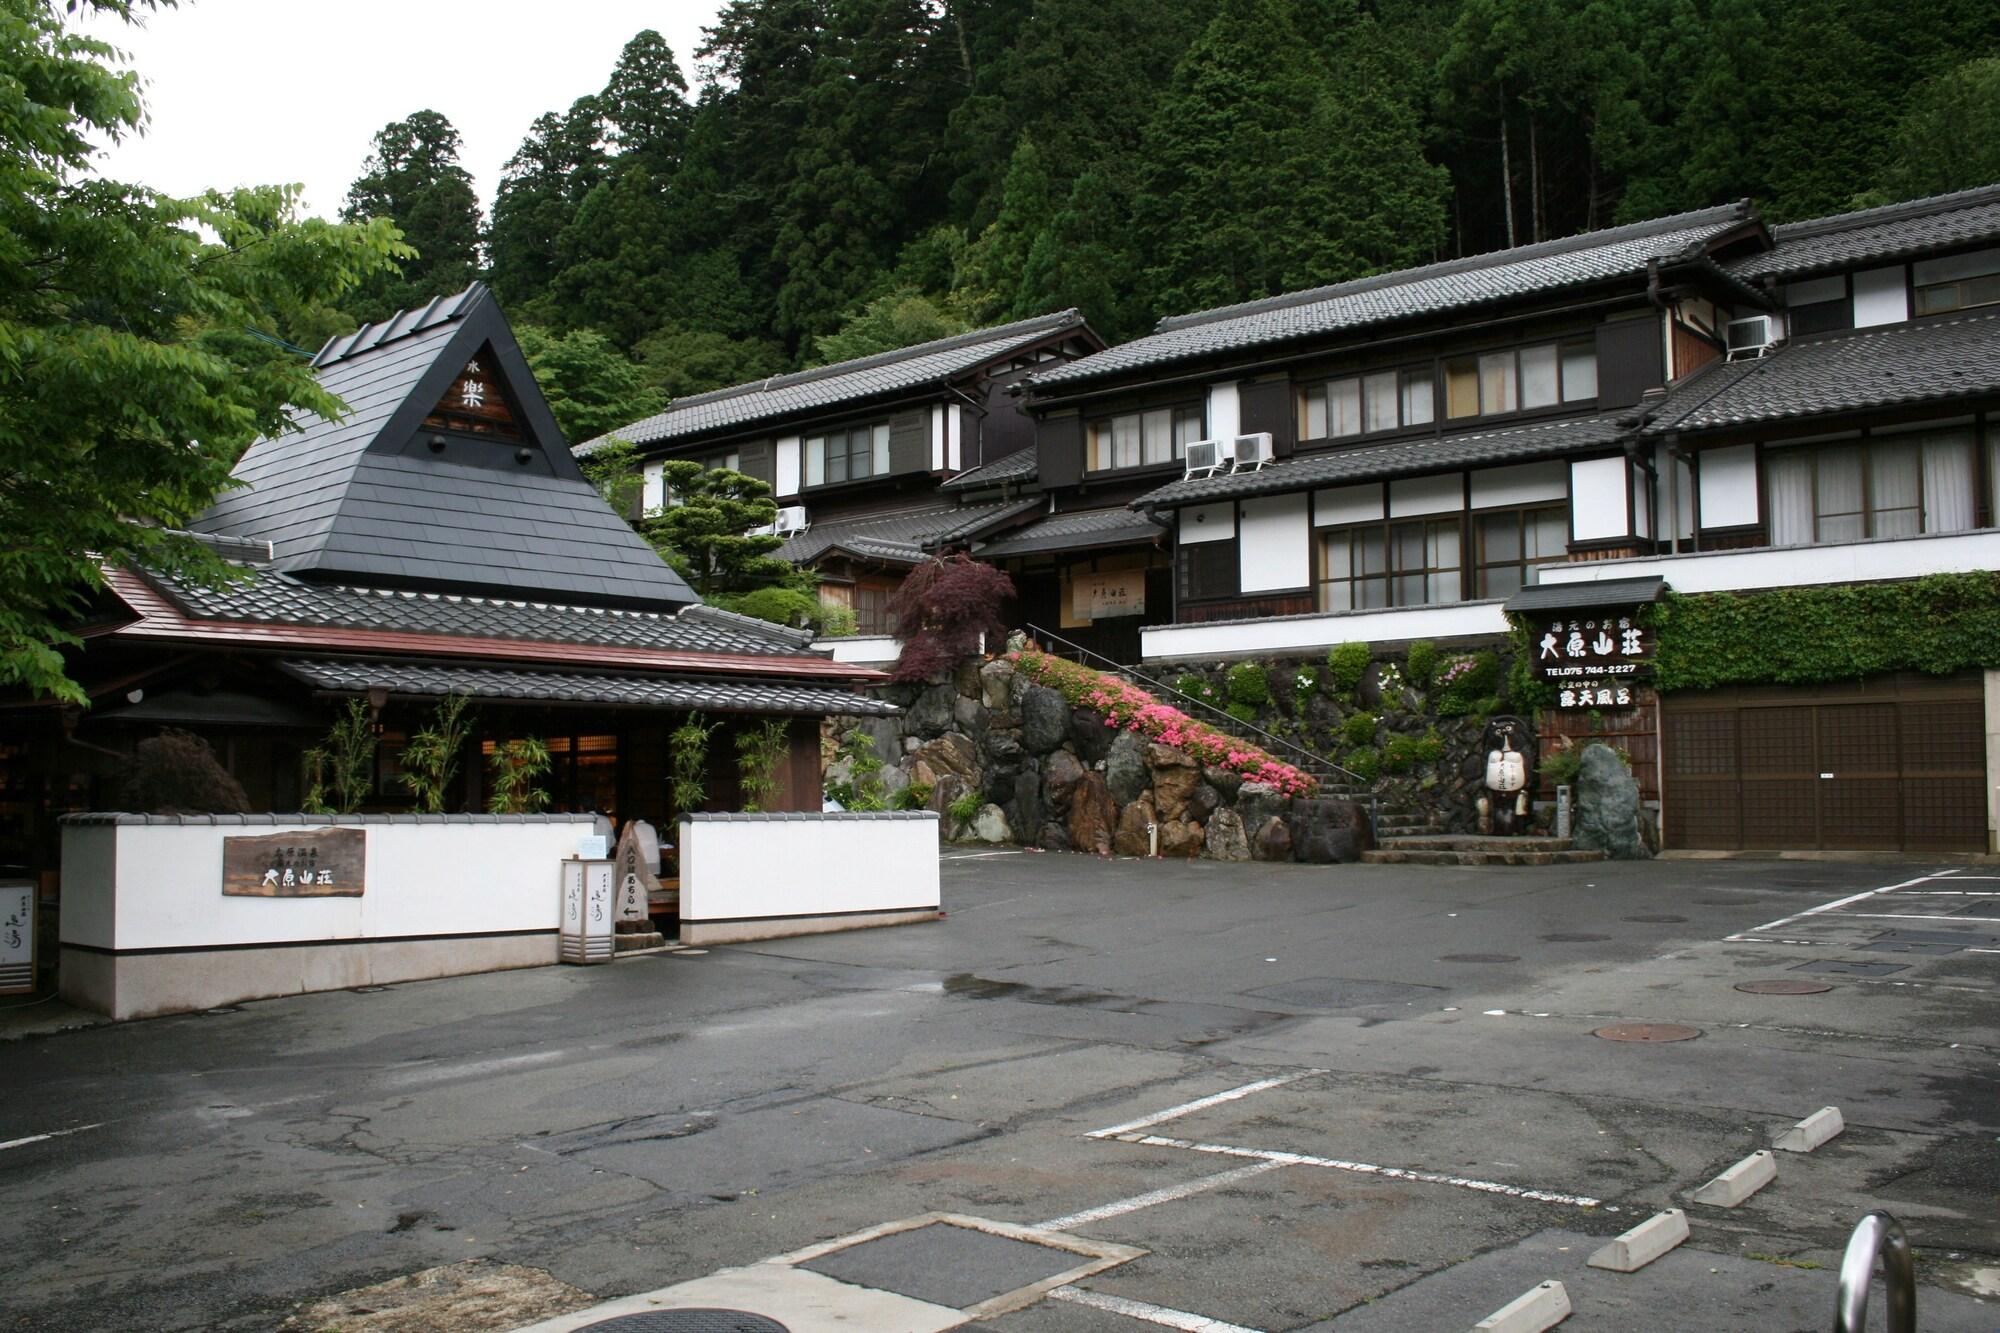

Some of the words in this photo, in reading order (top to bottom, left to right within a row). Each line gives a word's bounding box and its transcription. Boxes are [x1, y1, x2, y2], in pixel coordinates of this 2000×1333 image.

[1540, 628, 1644, 660] 大原山荘
[1585, 664, 1636, 675] 744-2227
[1559, 688, 1631, 707] 露天風呂
[262, 868, 334, 887] 大原山荘
